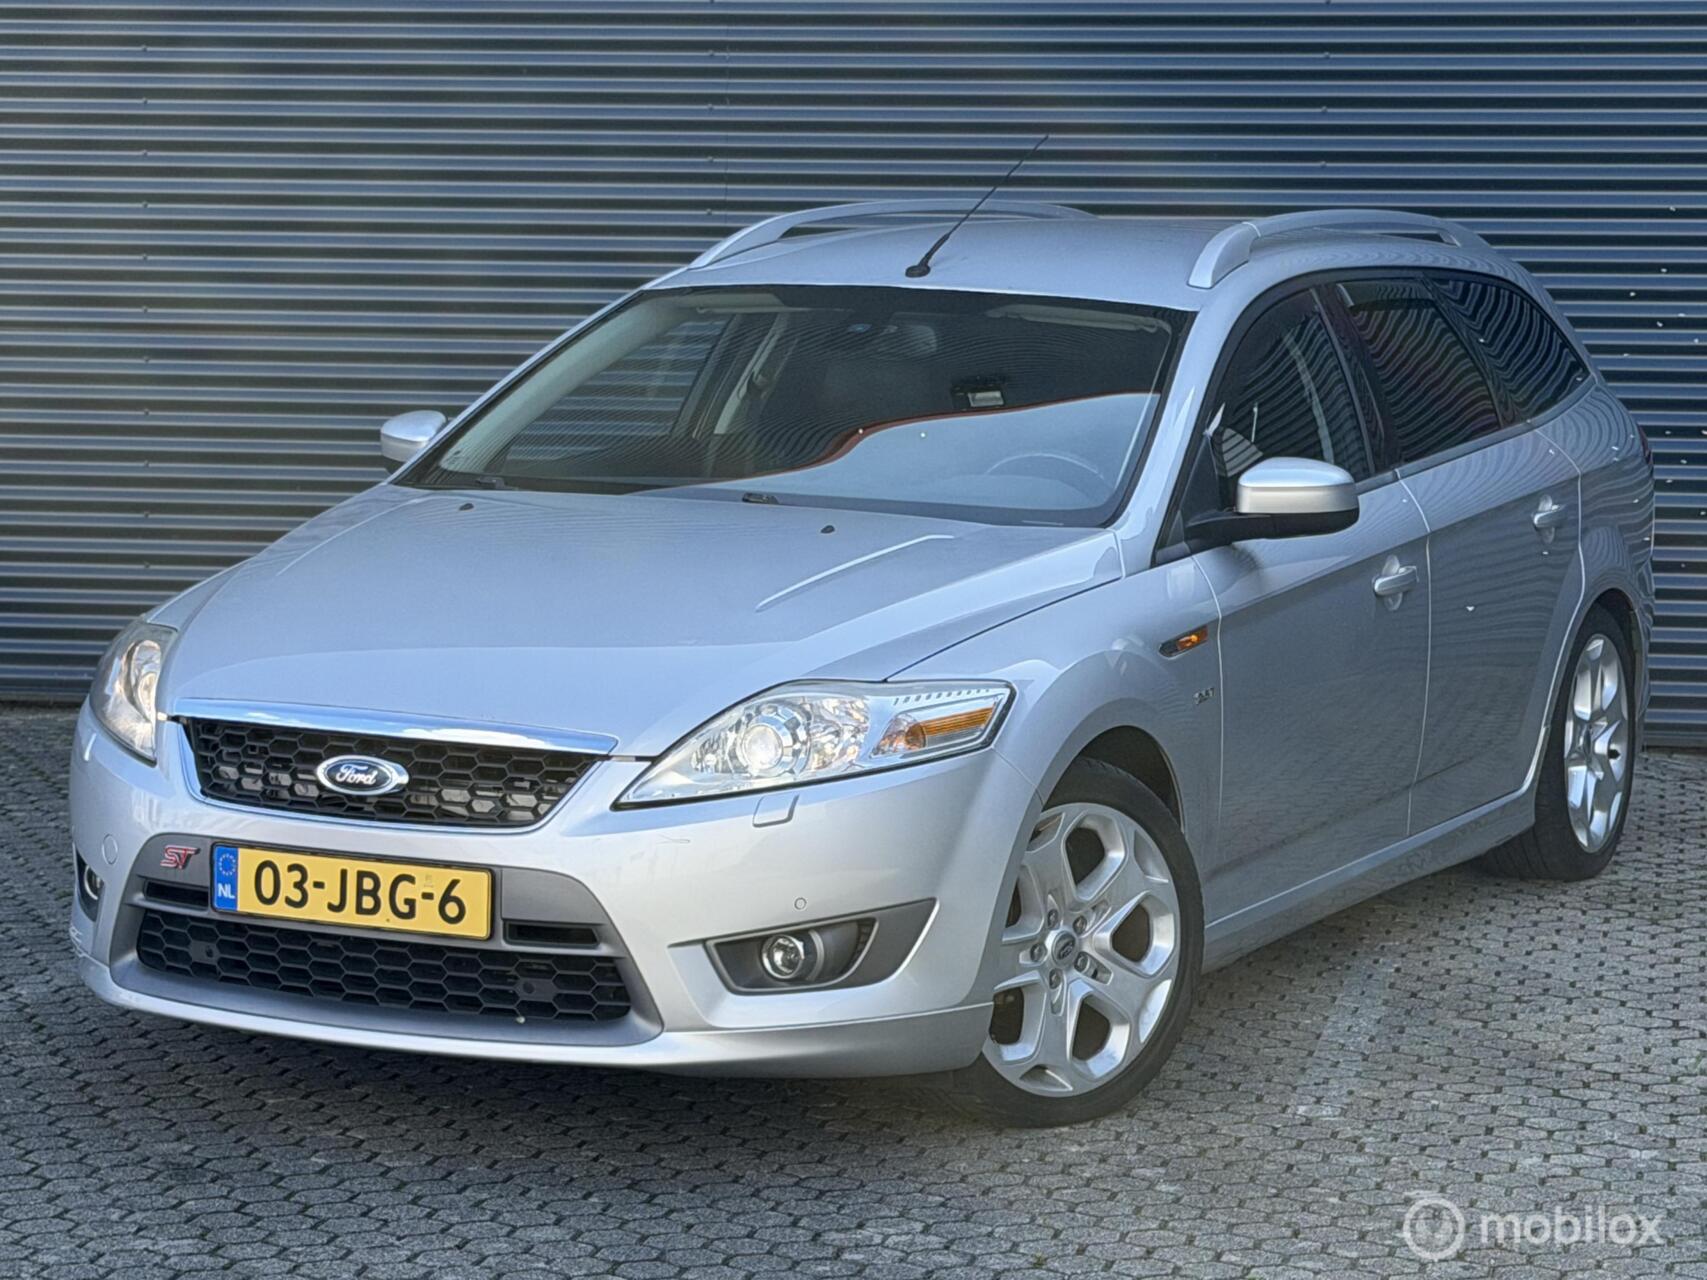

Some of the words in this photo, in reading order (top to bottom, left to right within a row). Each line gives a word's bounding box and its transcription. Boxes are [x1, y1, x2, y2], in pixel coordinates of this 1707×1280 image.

[335, 763, 378, 785] Ford
[160, 845, 200, 869] ST
[217, 883, 235, 899] NL
[254, 860, 466, 925] 03-JBG-6
